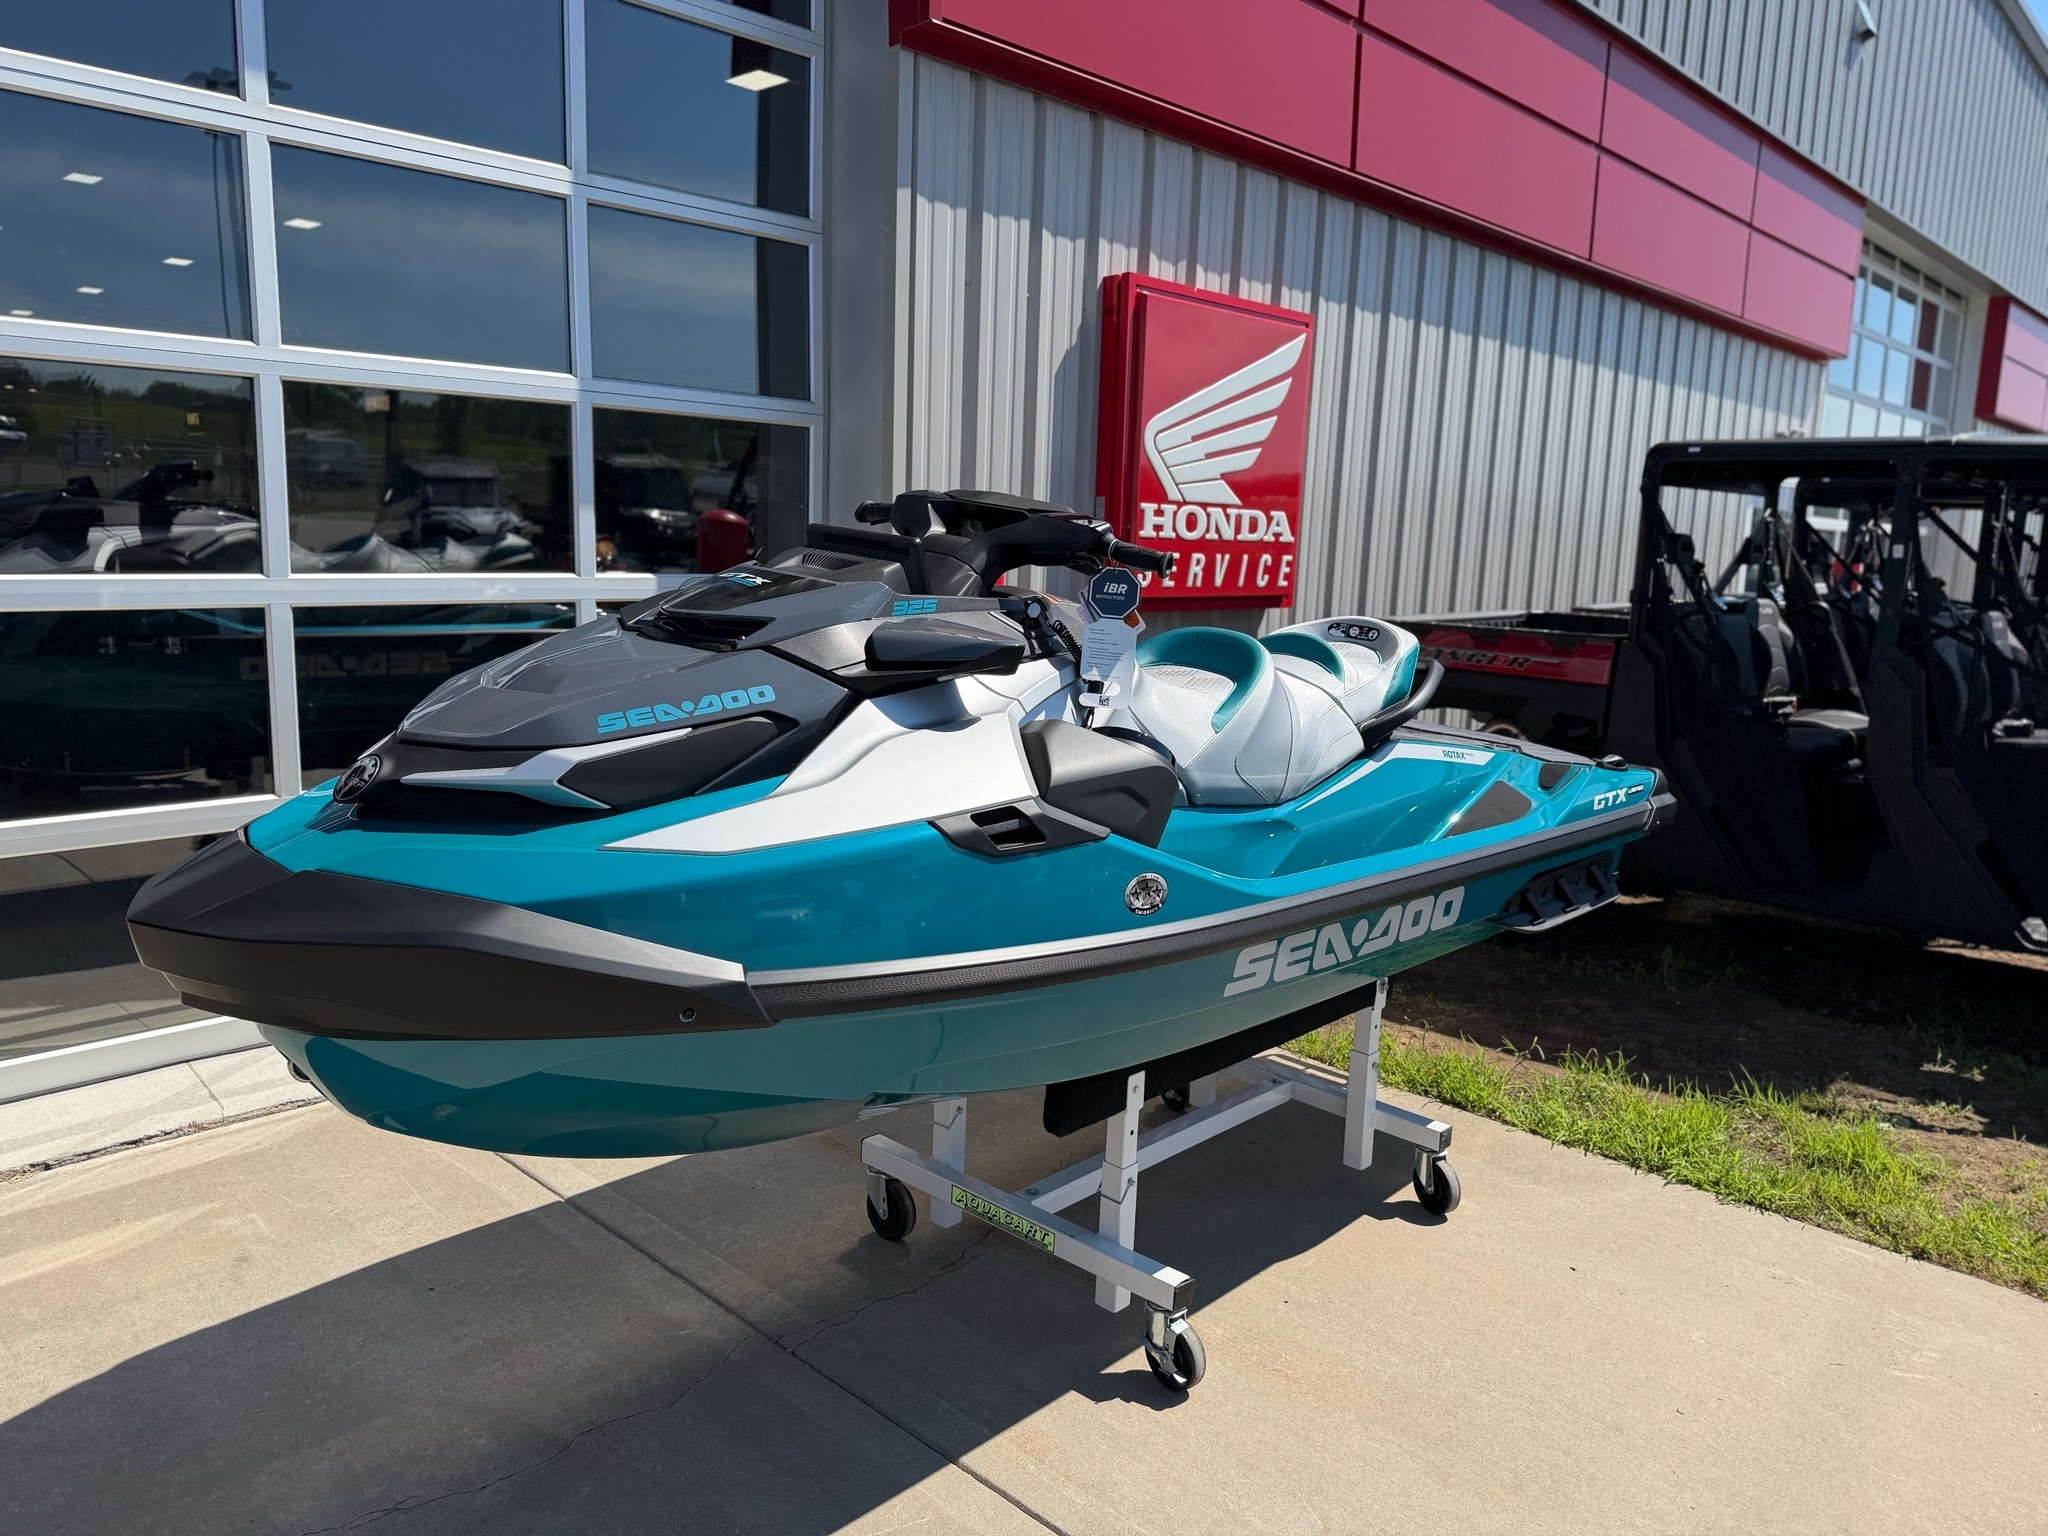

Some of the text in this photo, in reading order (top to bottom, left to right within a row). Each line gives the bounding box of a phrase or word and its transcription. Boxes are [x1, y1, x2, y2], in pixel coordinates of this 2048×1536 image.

[1138, 502, 1295, 543] HONDA
[1103, 582, 1128, 595] iBR
[892, 598, 938, 616] 325
[1421, 647, 1532, 670] ANGER
[1442, 750, 1466, 760] ROTAX
[1593, 787, 1628, 811] GTX
[955, 1190, 1050, 1242] AQUACART
